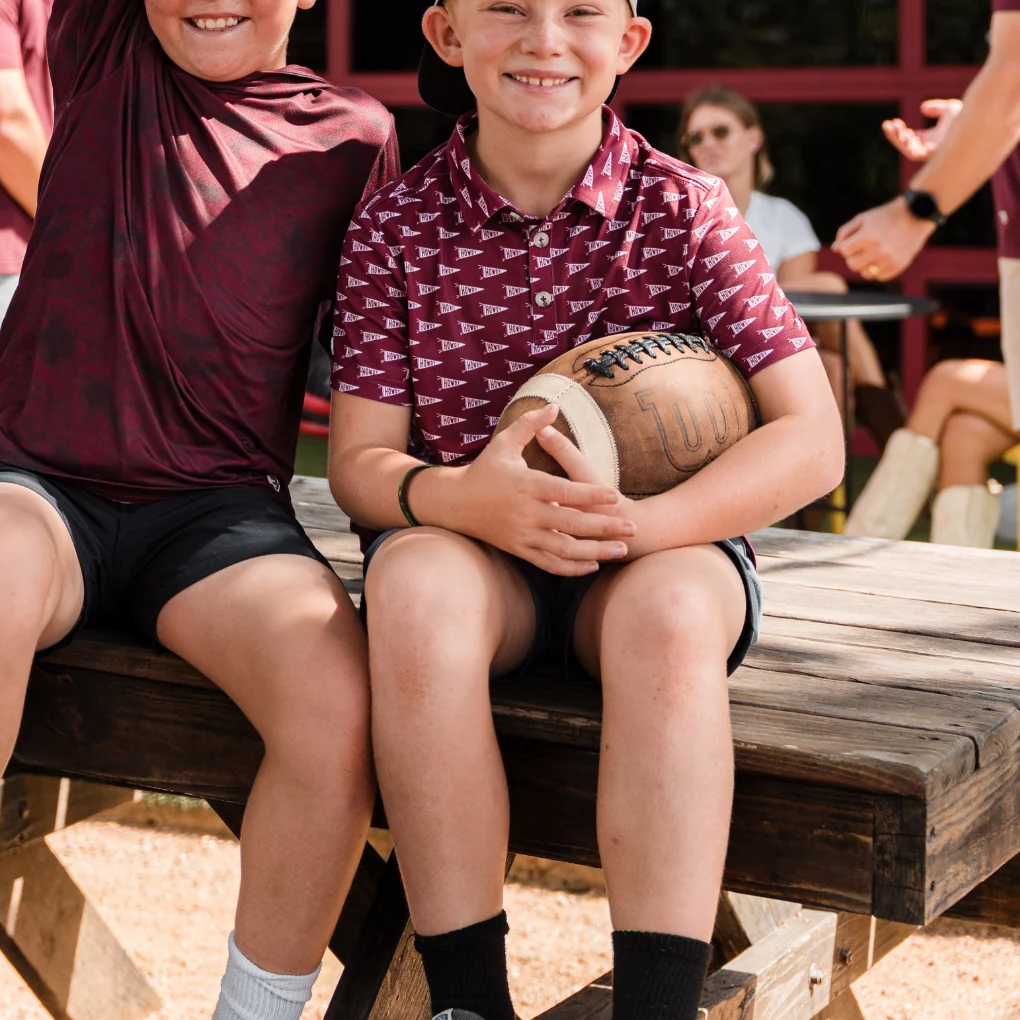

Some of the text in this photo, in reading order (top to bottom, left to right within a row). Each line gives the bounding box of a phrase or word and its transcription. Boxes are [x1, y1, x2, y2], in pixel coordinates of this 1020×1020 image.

[645, 177, 659, 186] HOWDY
[484, 230, 498, 239] HOWDY
[667, 229, 680, 239] HOWDY
[422, 248, 437, 257] HOWDY
[461, 249, 476, 258] HOWDY
[506, 249, 521, 259] HOWDY
[645, 248, 661, 258] HOWDY
[707, 254, 724, 267] HOWDY
[485, 267, 500, 277] HOWDY
[421, 285, 435, 294] HOWDY
[461, 286, 477, 295] HOWDY
[509, 287, 523, 297] HOWDY
[608, 288, 622, 296] HOWDY
[652, 285, 667, 295] HOWDY
[721, 289, 738, 301] HOWDY
[485, 305, 502, 315] HOWDY
[573, 302, 589, 311] HOWDY
[671, 303, 688, 312] HOWDY
[631, 307, 648, 316] HOWDY
[420, 321, 435, 331] HOWDY
[463, 323, 478, 333] HOWDY
[509, 325, 524, 334] HOWDY
[609, 325, 625, 333] HOWDY
[733, 321, 750, 333] HOWDY
[444, 341, 460, 350] HOWDY
[487, 343, 502, 352] HOWDY
[387, 351, 401, 361] HOWDY
[749, 352, 767, 365] HOWDY
[420, 359, 436, 368] HOWDY
[467, 360, 481, 370] HOWDY
[511, 361, 527, 371] HOWDY
[444, 379, 460, 388] HOWDY
[491, 380, 506, 389] HOWDY
[385, 388, 400, 396] HOWDY
[420, 397, 435, 405] HOWDY
[468, 399, 484, 407] HOWDY
[443, 416, 460, 425] HOWDY
